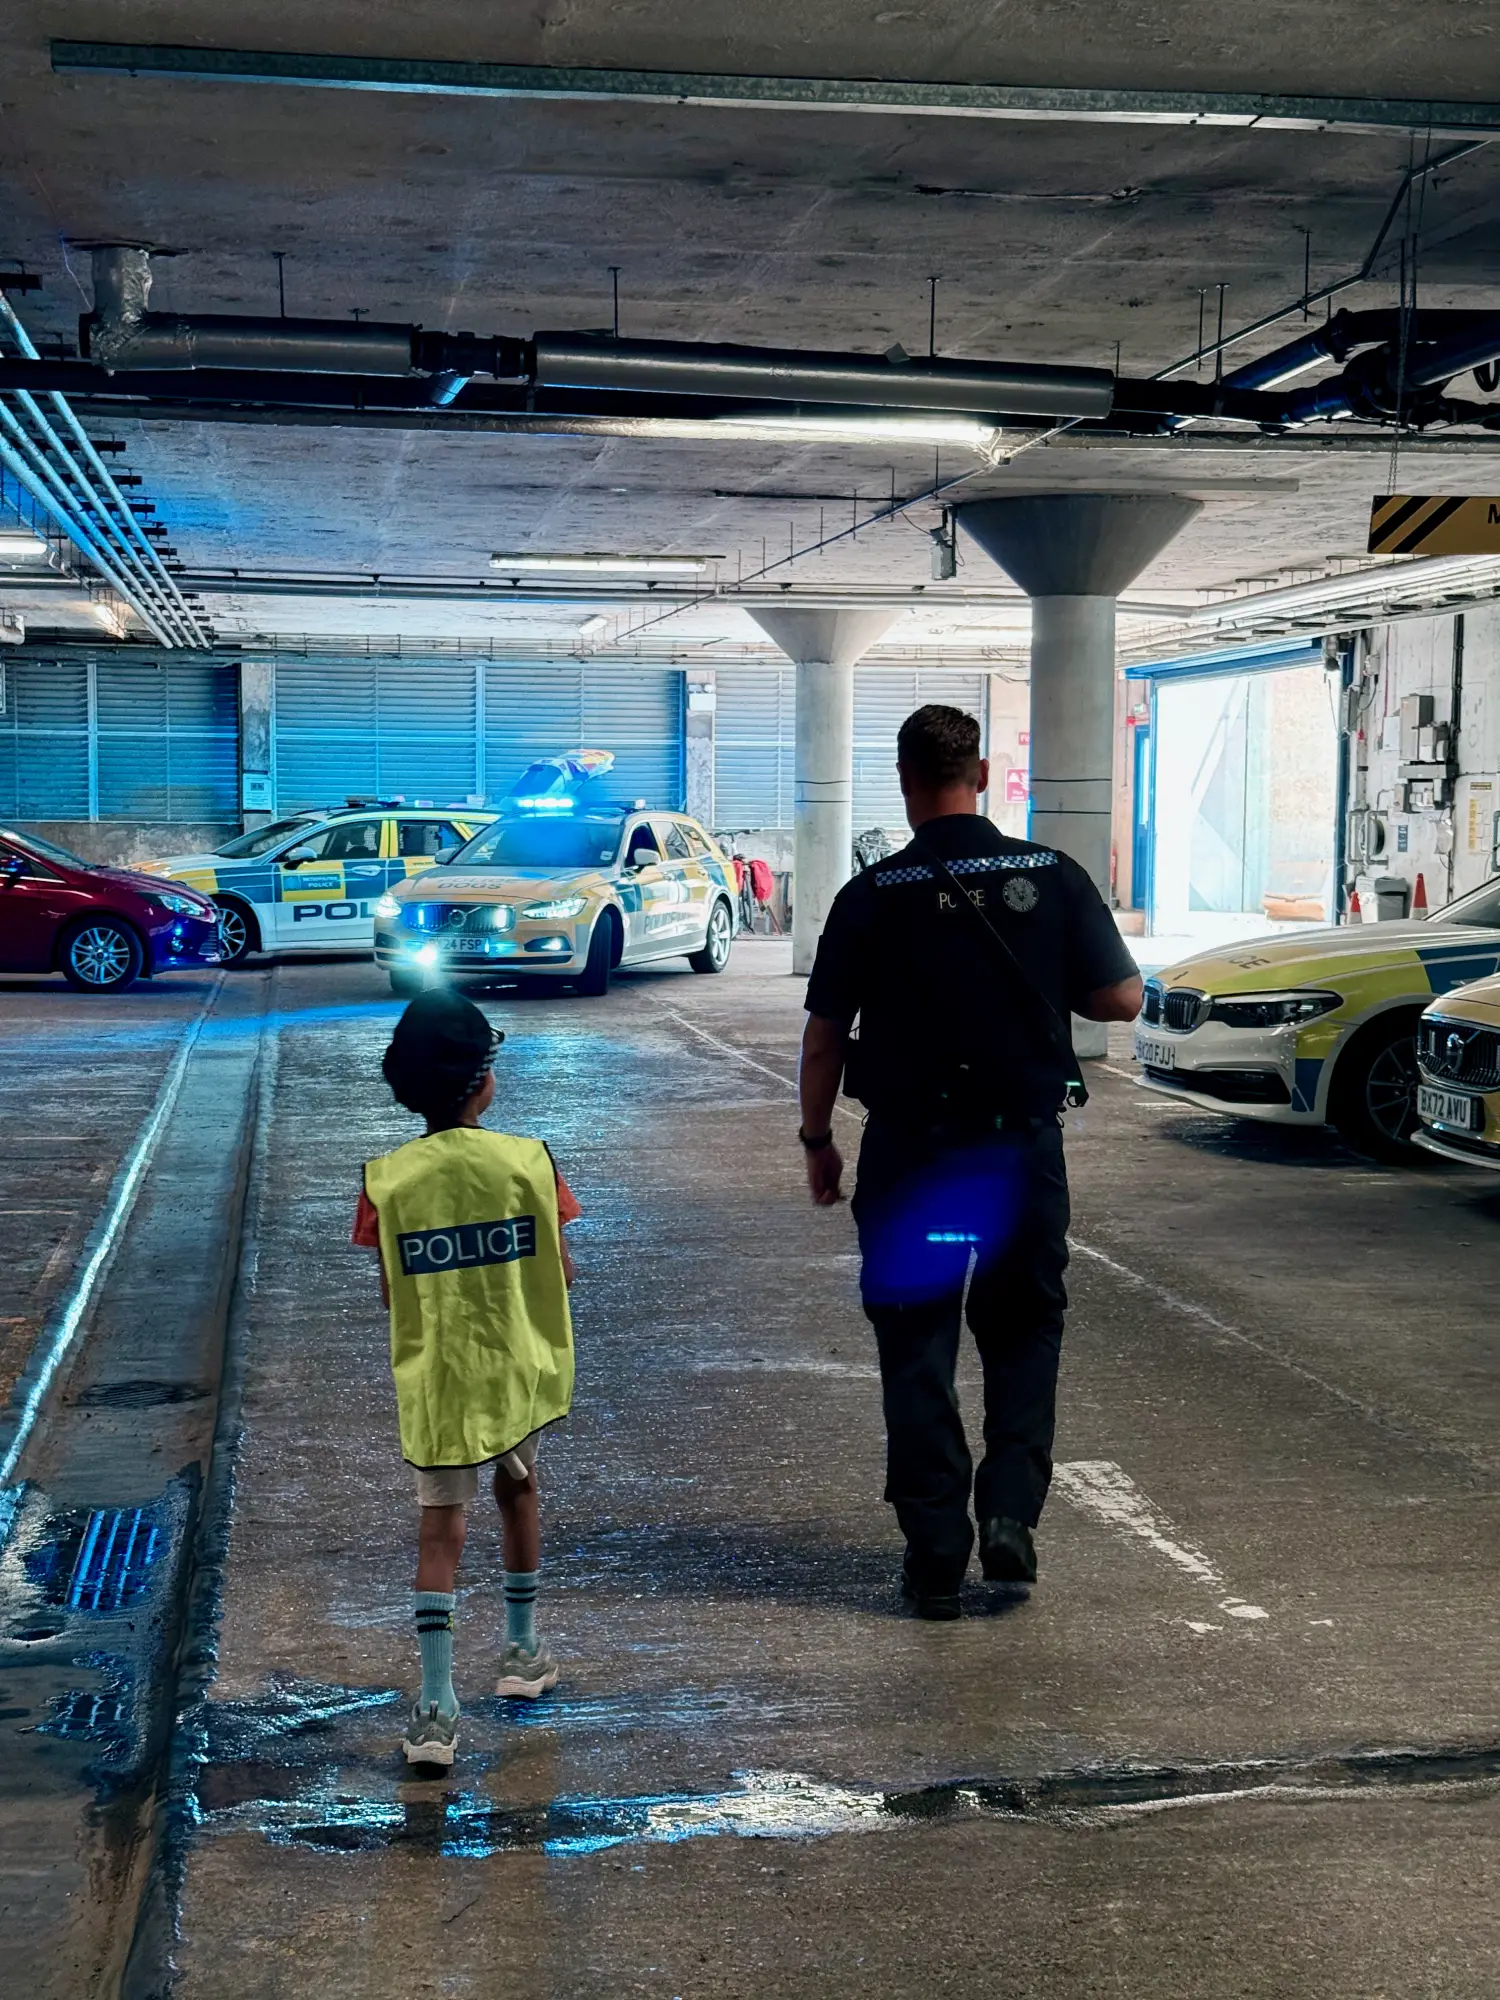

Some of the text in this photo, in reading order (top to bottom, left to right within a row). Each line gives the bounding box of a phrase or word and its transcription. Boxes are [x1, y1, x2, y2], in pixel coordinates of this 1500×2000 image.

[437, 882, 502, 890] DOGS
[938, 889, 985, 910] POCE
[460, 939, 482, 951] FSP
[1154, 1044, 1171, 1066] FJJ
[1420, 1089, 1467, 1123] BX72 AVU
[403, 1222, 531, 1267] POLICE
